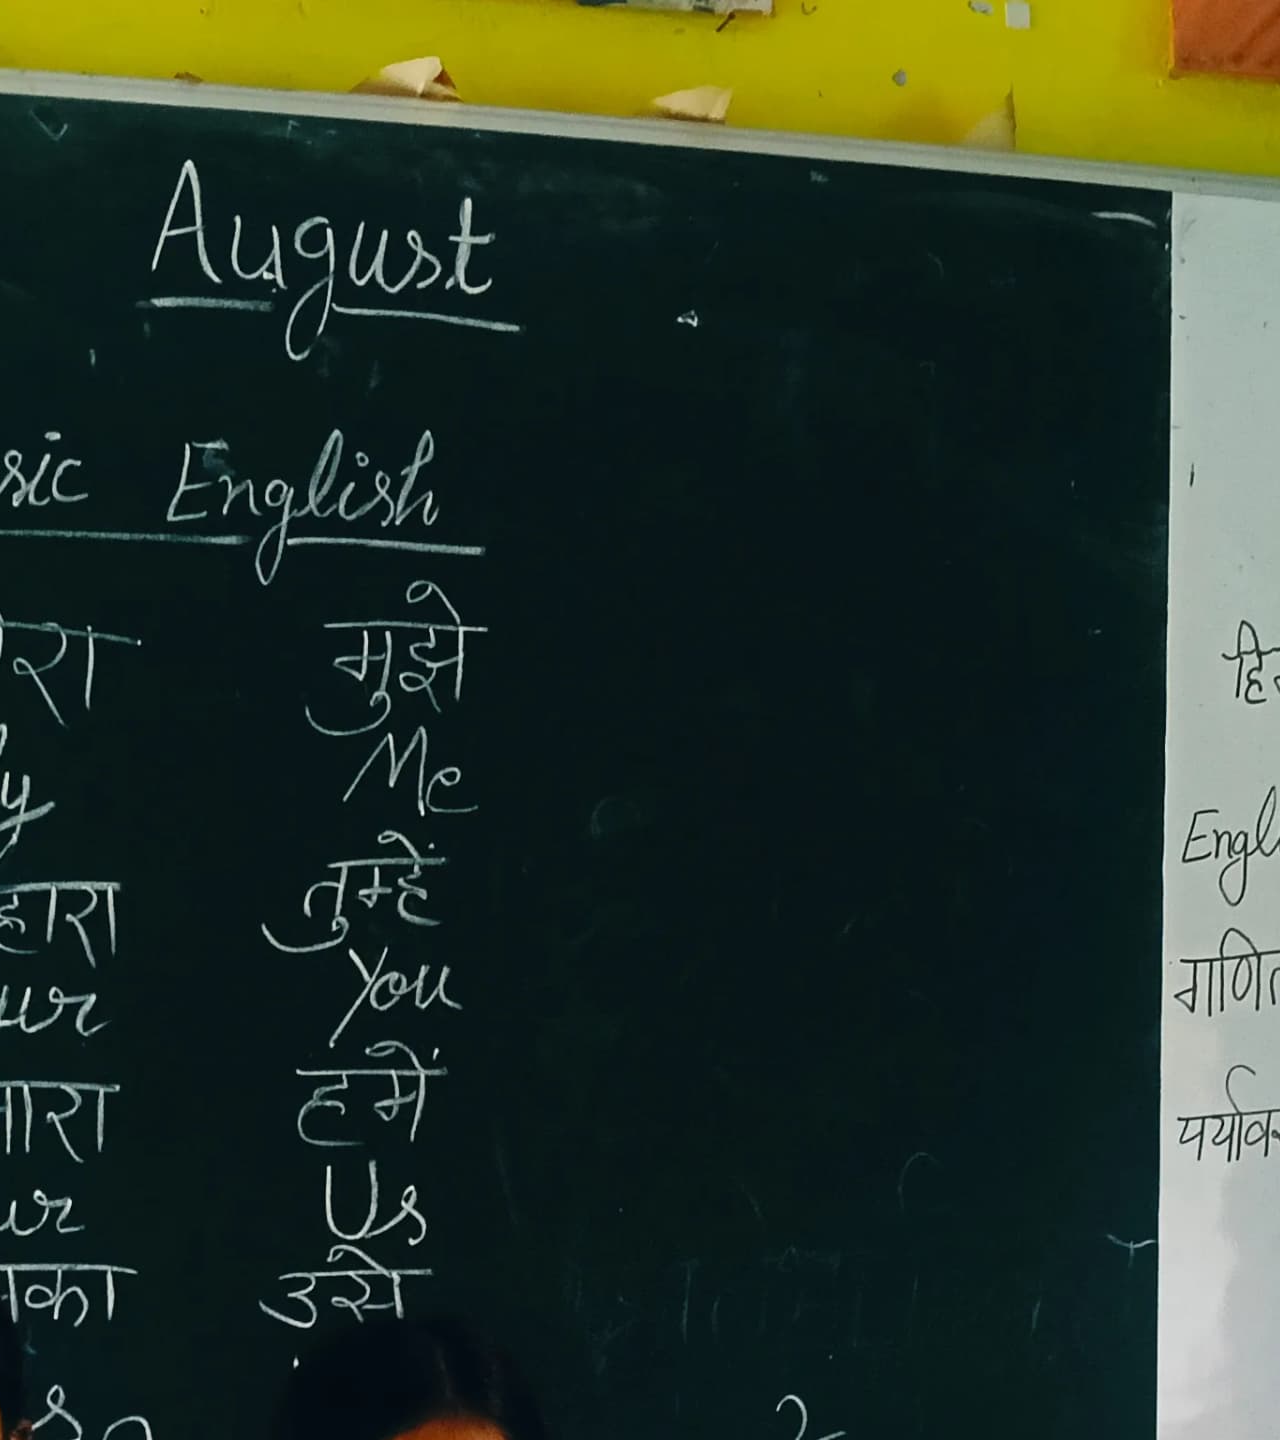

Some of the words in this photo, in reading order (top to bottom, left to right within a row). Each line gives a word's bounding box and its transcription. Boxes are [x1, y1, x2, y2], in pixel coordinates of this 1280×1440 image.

[152, 159, 495, 361] August
[167, 428, 439, 586] English
[305, 578, 489, 736] मुझे
[343, 725, 479, 817] Me
[328, 944, 462, 1049] You
[295, 1039, 448, 1146] हमें
[325, 1159, 427, 1246] Us
[258, 1244, 432, 1328] उसे
